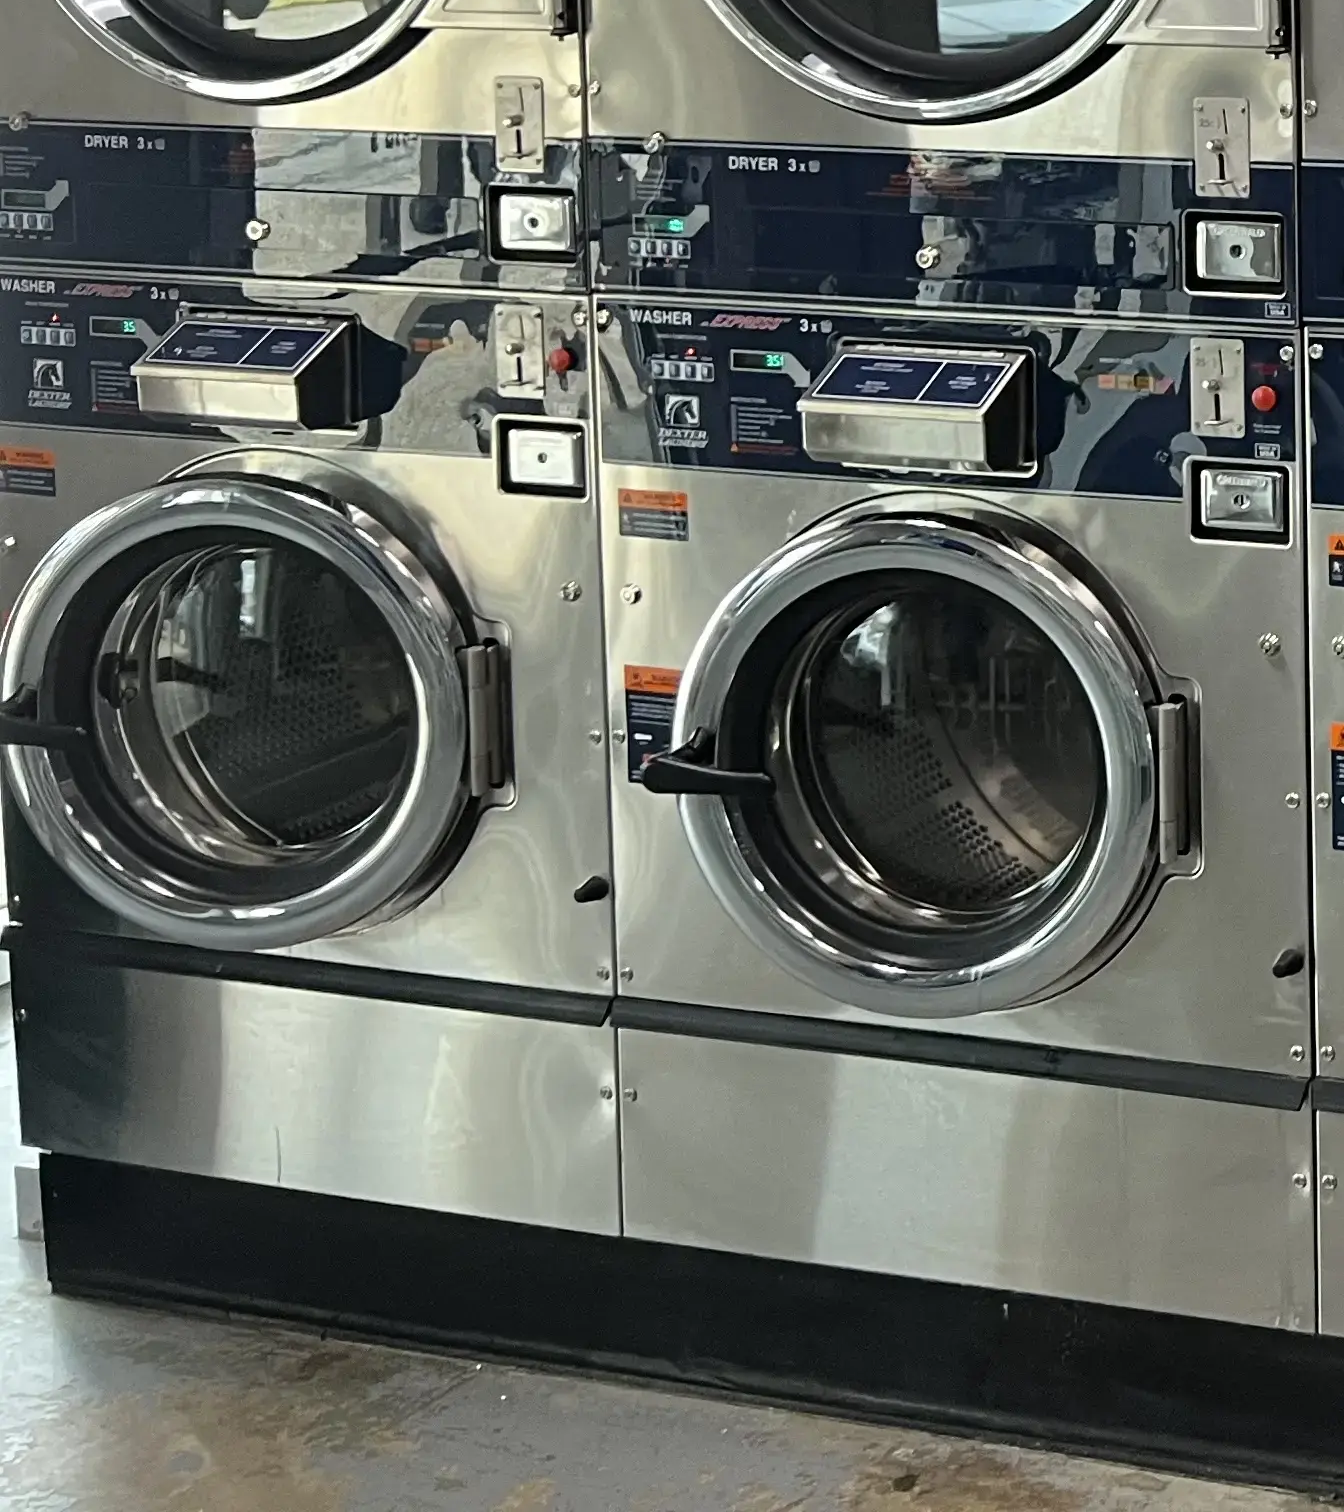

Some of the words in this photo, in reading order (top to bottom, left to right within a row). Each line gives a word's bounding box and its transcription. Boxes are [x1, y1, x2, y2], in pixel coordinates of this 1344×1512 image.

[85, 135, 129, 149] DRYER
[728, 155, 778, 173] DRYER
[0, 279, 55, 294] WASHER
[630, 308, 692, 325] WASHER
